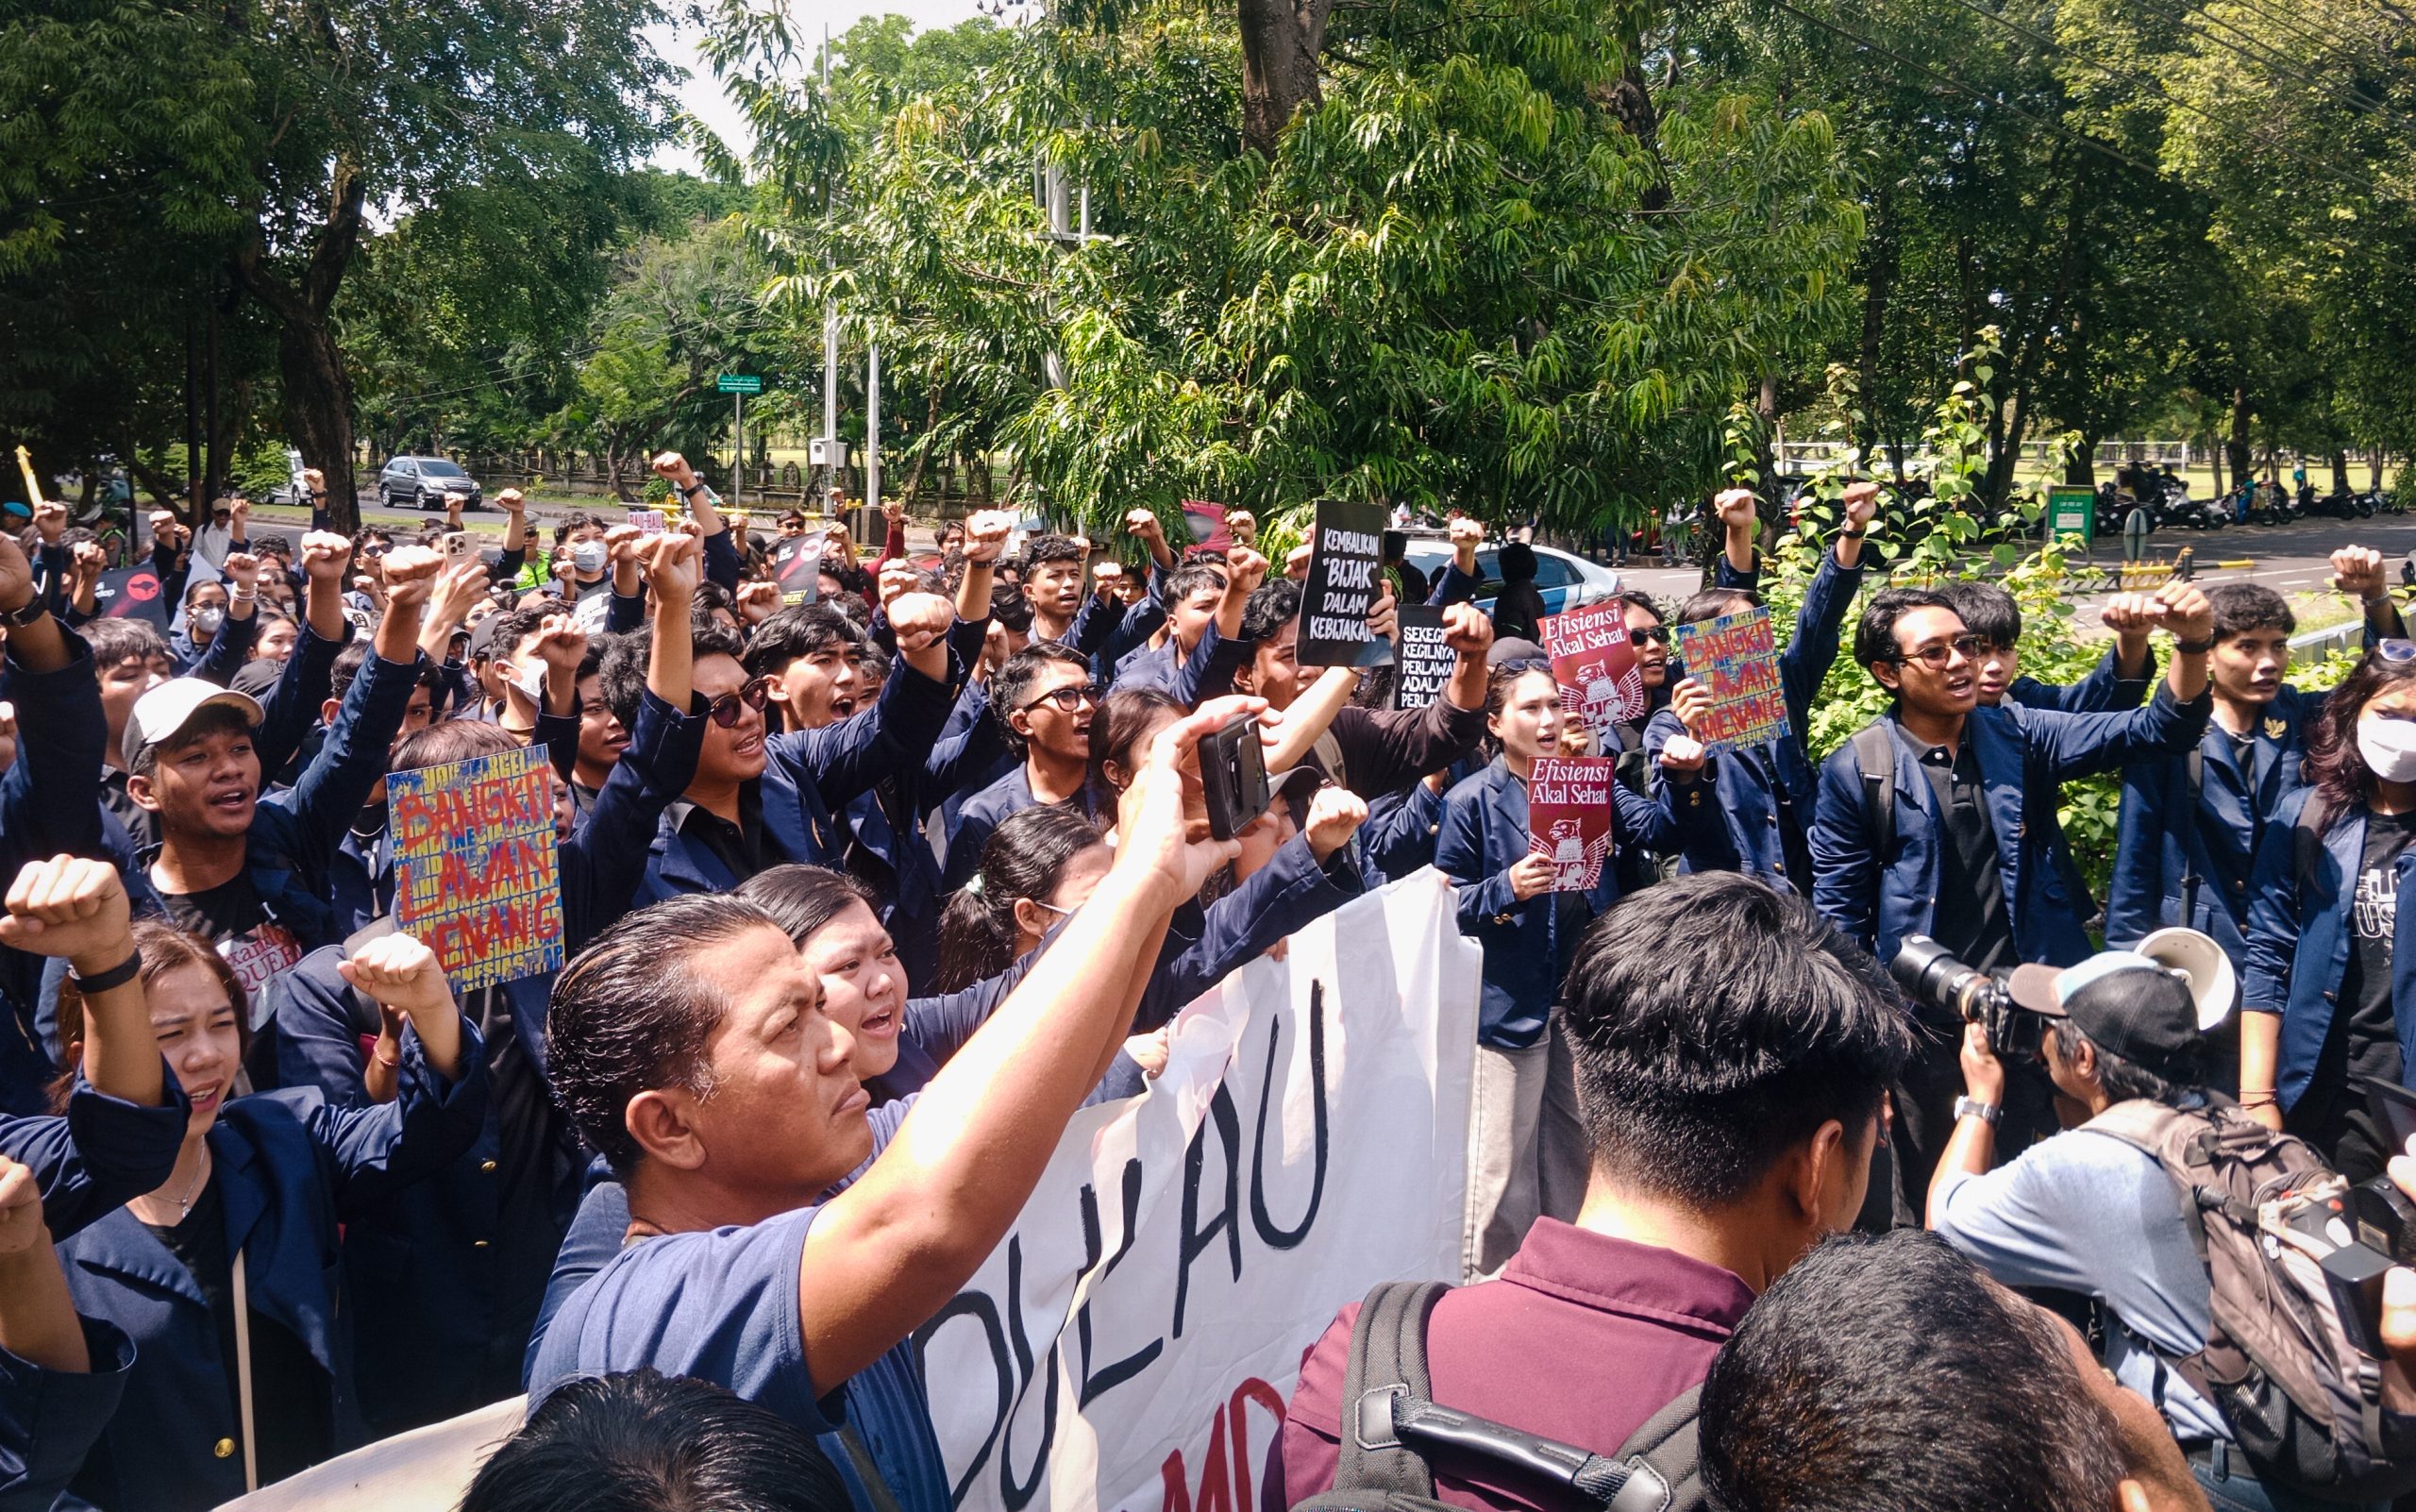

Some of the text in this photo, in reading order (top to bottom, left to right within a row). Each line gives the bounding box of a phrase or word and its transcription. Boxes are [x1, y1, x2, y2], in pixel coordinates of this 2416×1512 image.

[1323, 528, 1379, 556] KEMBALIKAN
[1322, 592, 1367, 614] DALAM
[1544, 603, 1620, 641] Efisiensi
[1403, 627, 1447, 644] SEKECI
[1550, 627, 1626, 659] Akal Sehat
[1402, 644, 1455, 660] KECILNYA
[1402, 660, 1454, 676] PERLAWA
[1711, 658, 1779, 701] AWAN
[1401, 676, 1449, 692] ADALA
[1401, 693, 1437, 708] PERLA
[1530, 759, 1611, 785] Efisiensi
[1530, 783, 1608, 804] Akal Sehat
[397, 767, 553, 852] BANGKIT
[401, 832, 551, 922] LAWAN
[236, 945, 298, 991] QUEE
